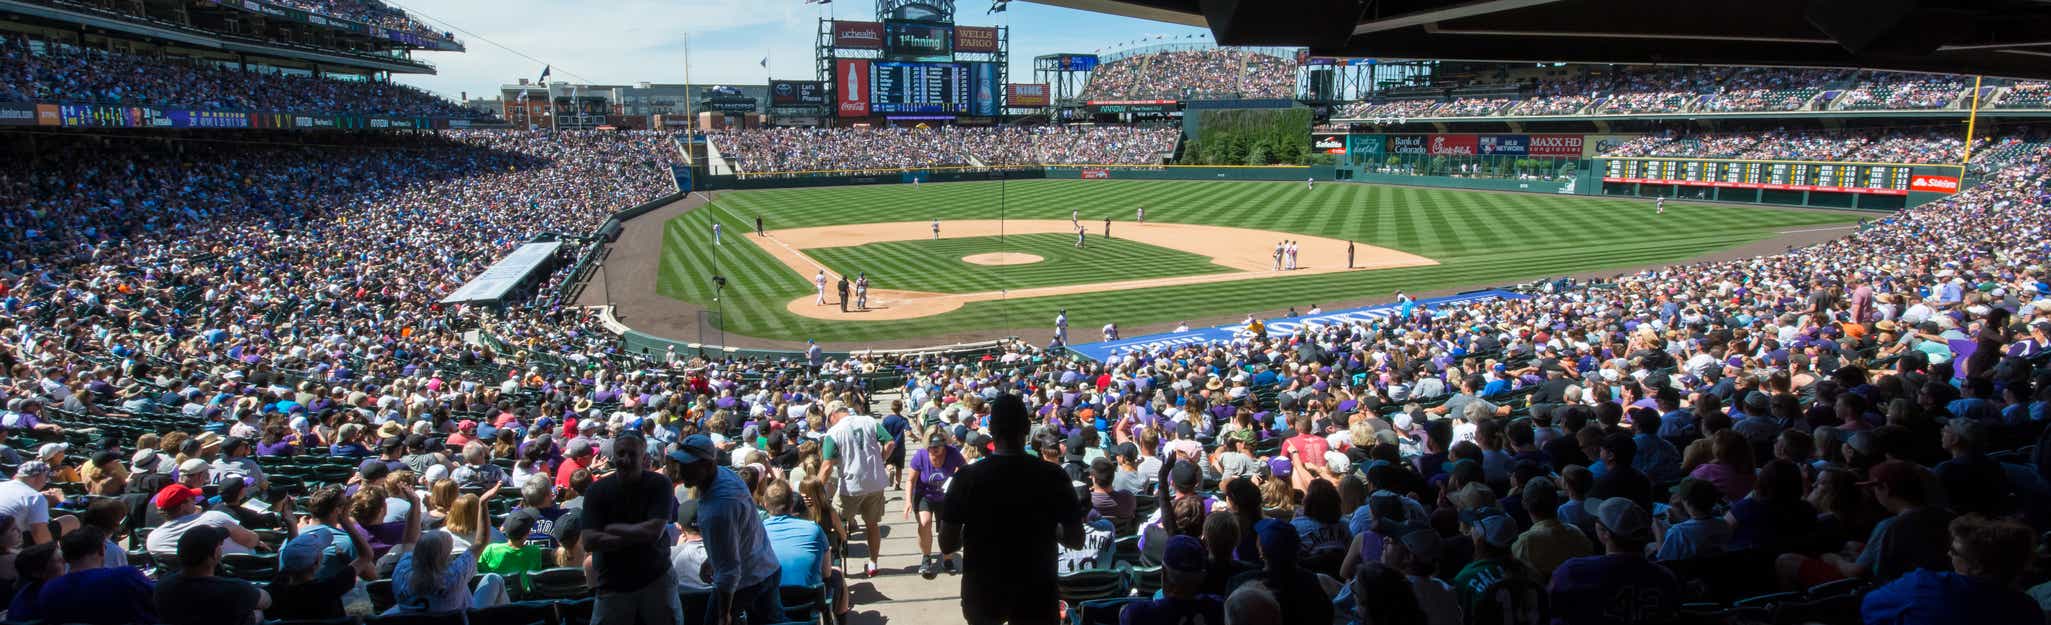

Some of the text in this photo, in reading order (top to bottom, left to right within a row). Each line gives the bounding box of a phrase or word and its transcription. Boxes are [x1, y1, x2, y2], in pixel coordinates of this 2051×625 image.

[960, 30, 992, 38] WELLS
[911, 35, 941, 49] Inning
[960, 38, 992, 47] FARGO
[1395, 137, 1411, 145] Bank
[1530, 138, 1582, 147] MAXX HD
[1394, 145, 1426, 153] Colorado
